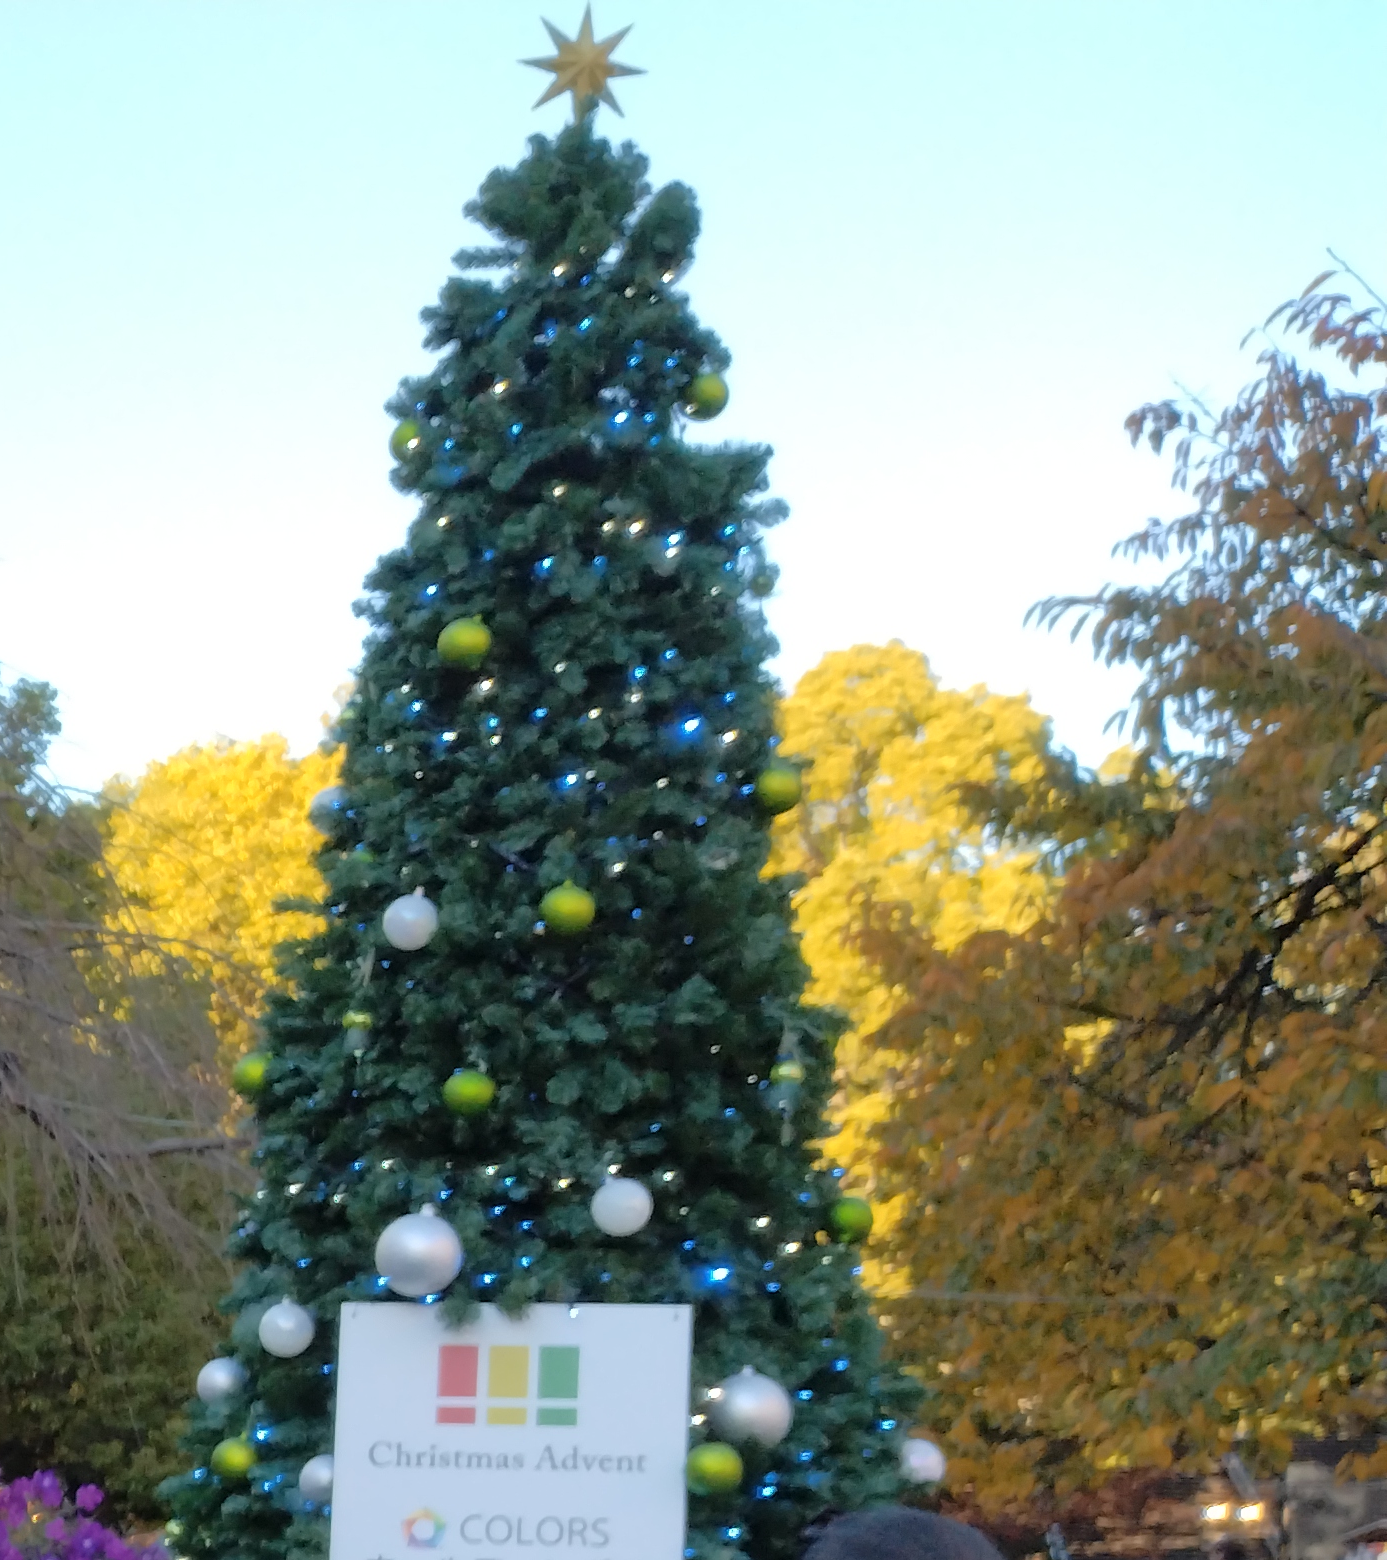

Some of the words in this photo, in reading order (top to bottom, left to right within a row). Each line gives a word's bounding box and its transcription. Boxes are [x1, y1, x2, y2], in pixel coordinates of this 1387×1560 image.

[368, 1440, 525, 1471] Christmas
[534, 1444, 647, 1473] Advent
[459, 1513, 611, 1547] COLORS
